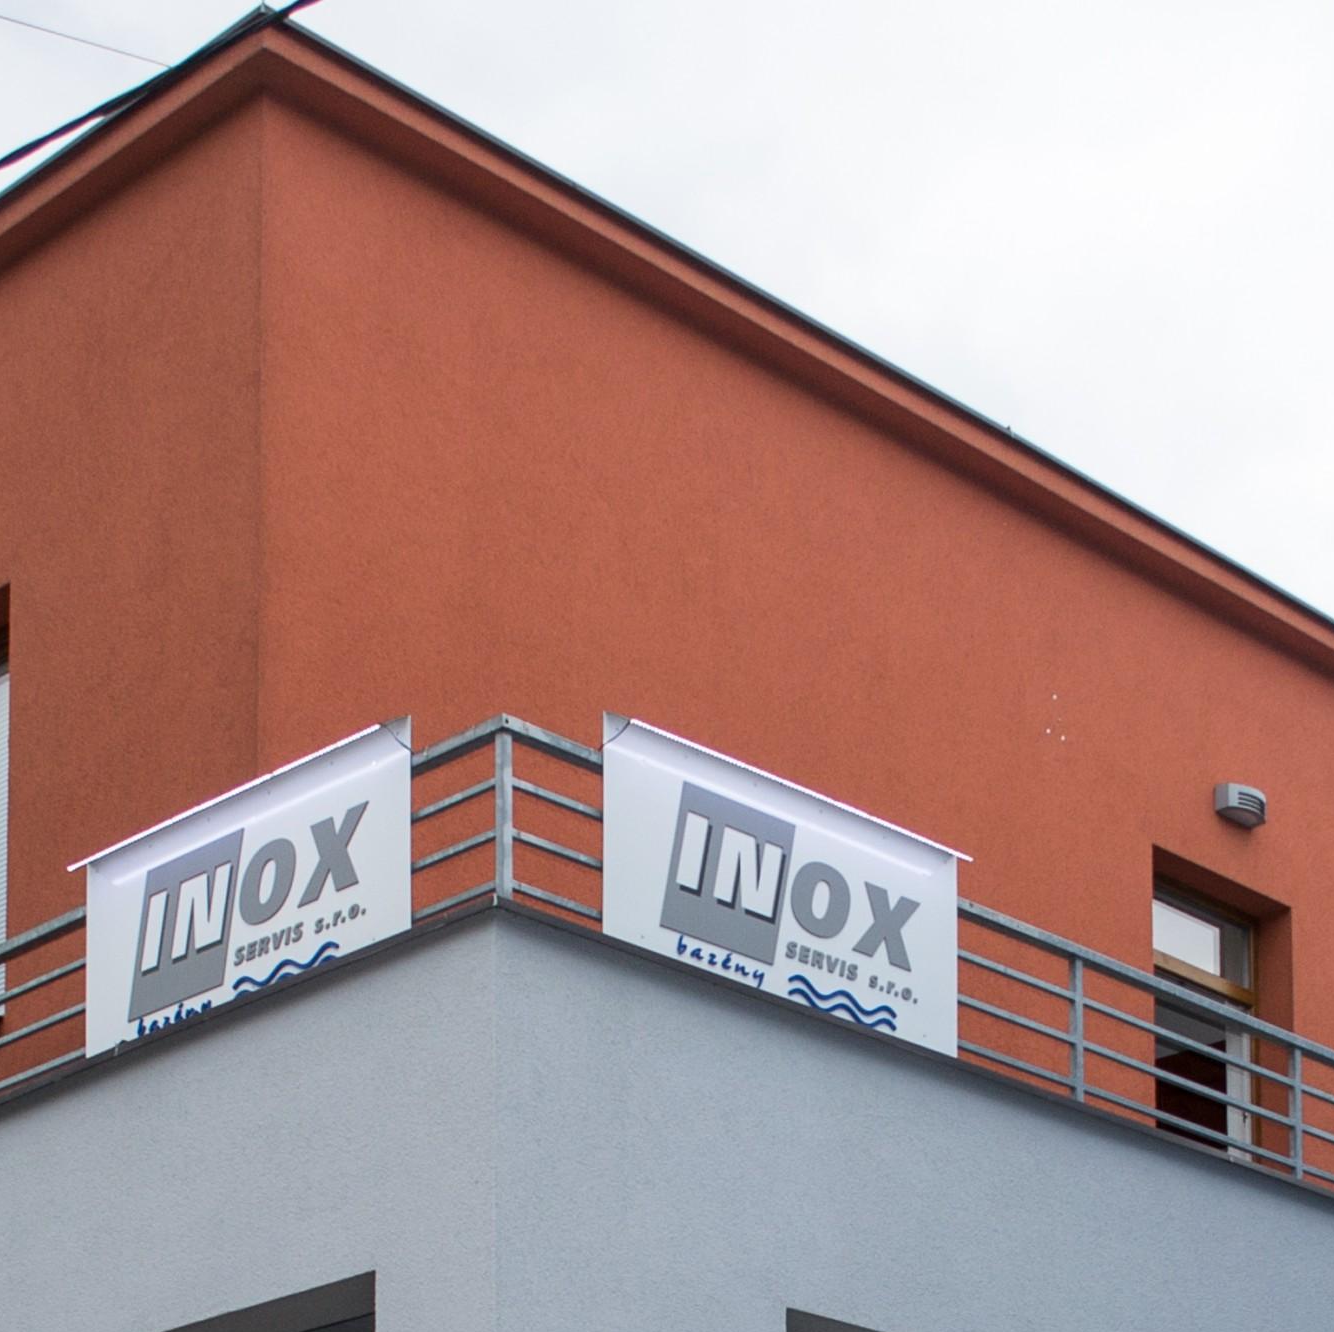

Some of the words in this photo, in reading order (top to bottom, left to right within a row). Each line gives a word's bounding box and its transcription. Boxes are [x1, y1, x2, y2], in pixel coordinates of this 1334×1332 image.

[139, 800, 370, 978] INOX
[675, 809, 922, 973] INOX
[233, 922, 304, 967] SERVIS
[314, 903, 367, 934] s.r.o.
[676, 934, 766, 989] bazény
[784, 940, 859, 982] SERVIS
[868, 974, 919, 1005] s.r.o.
